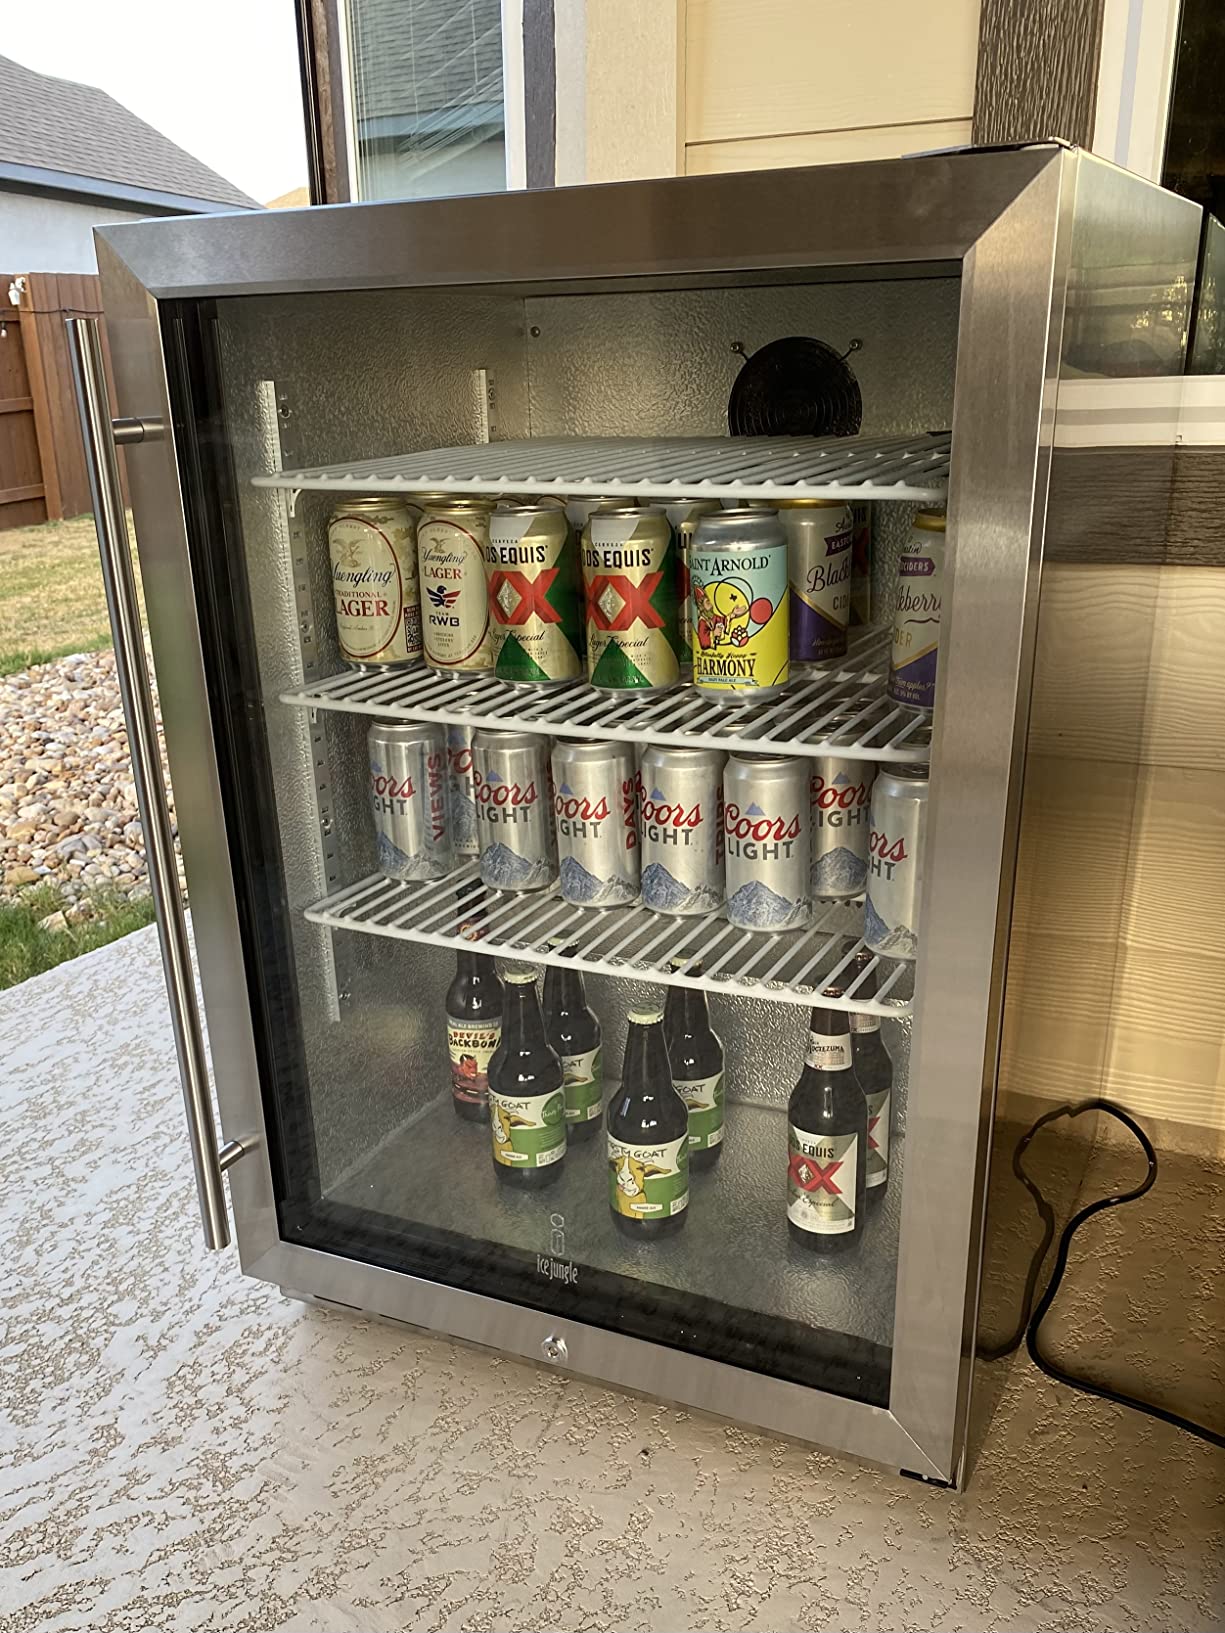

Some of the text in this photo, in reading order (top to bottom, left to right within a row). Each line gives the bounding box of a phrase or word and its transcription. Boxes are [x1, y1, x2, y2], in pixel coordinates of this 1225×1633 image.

[421, 546, 468, 567] Yuengling
[485, 545, 546, 565] OS EQUIS
[602, 548, 652, 569] EQUIS
[423, 565, 463, 580] LAGER
[689, 555, 769, 576] AINT ARNOLD
[901, 560, 930, 573] CIDERS
[335, 589, 383, 599] RADITIONAL
[429, 614, 460, 627] RWB
[505, 629, 546, 643] pecial
[607, 635, 650, 649] pecial
[894, 627, 913, 649] DER
[696, 657, 756, 677] HARMONY
[374, 776, 417, 798] ors
[427, 752, 446, 842] VIEWS
[373, 795, 407, 816] GHT
[554, 781, 612, 821] oors
[622, 777, 637, 850] DAYS
[725, 803, 802, 842] Coors
[812, 807, 871, 828] IGHT
[557, 818, 603, 839] IGHT
[727, 836, 794, 861] LIGHT
[869, 831, 908, 862] ors
[448, 1033, 501, 1049] BACKBON
[453, 1031, 496, 1040] DEVIL'S
[561, 1058, 585, 1068] OAT
[501, 1100, 531, 1110] GOAT
[633, 1148, 668, 1158] GOAT
[802, 1143, 835, 1159] EQUIS
